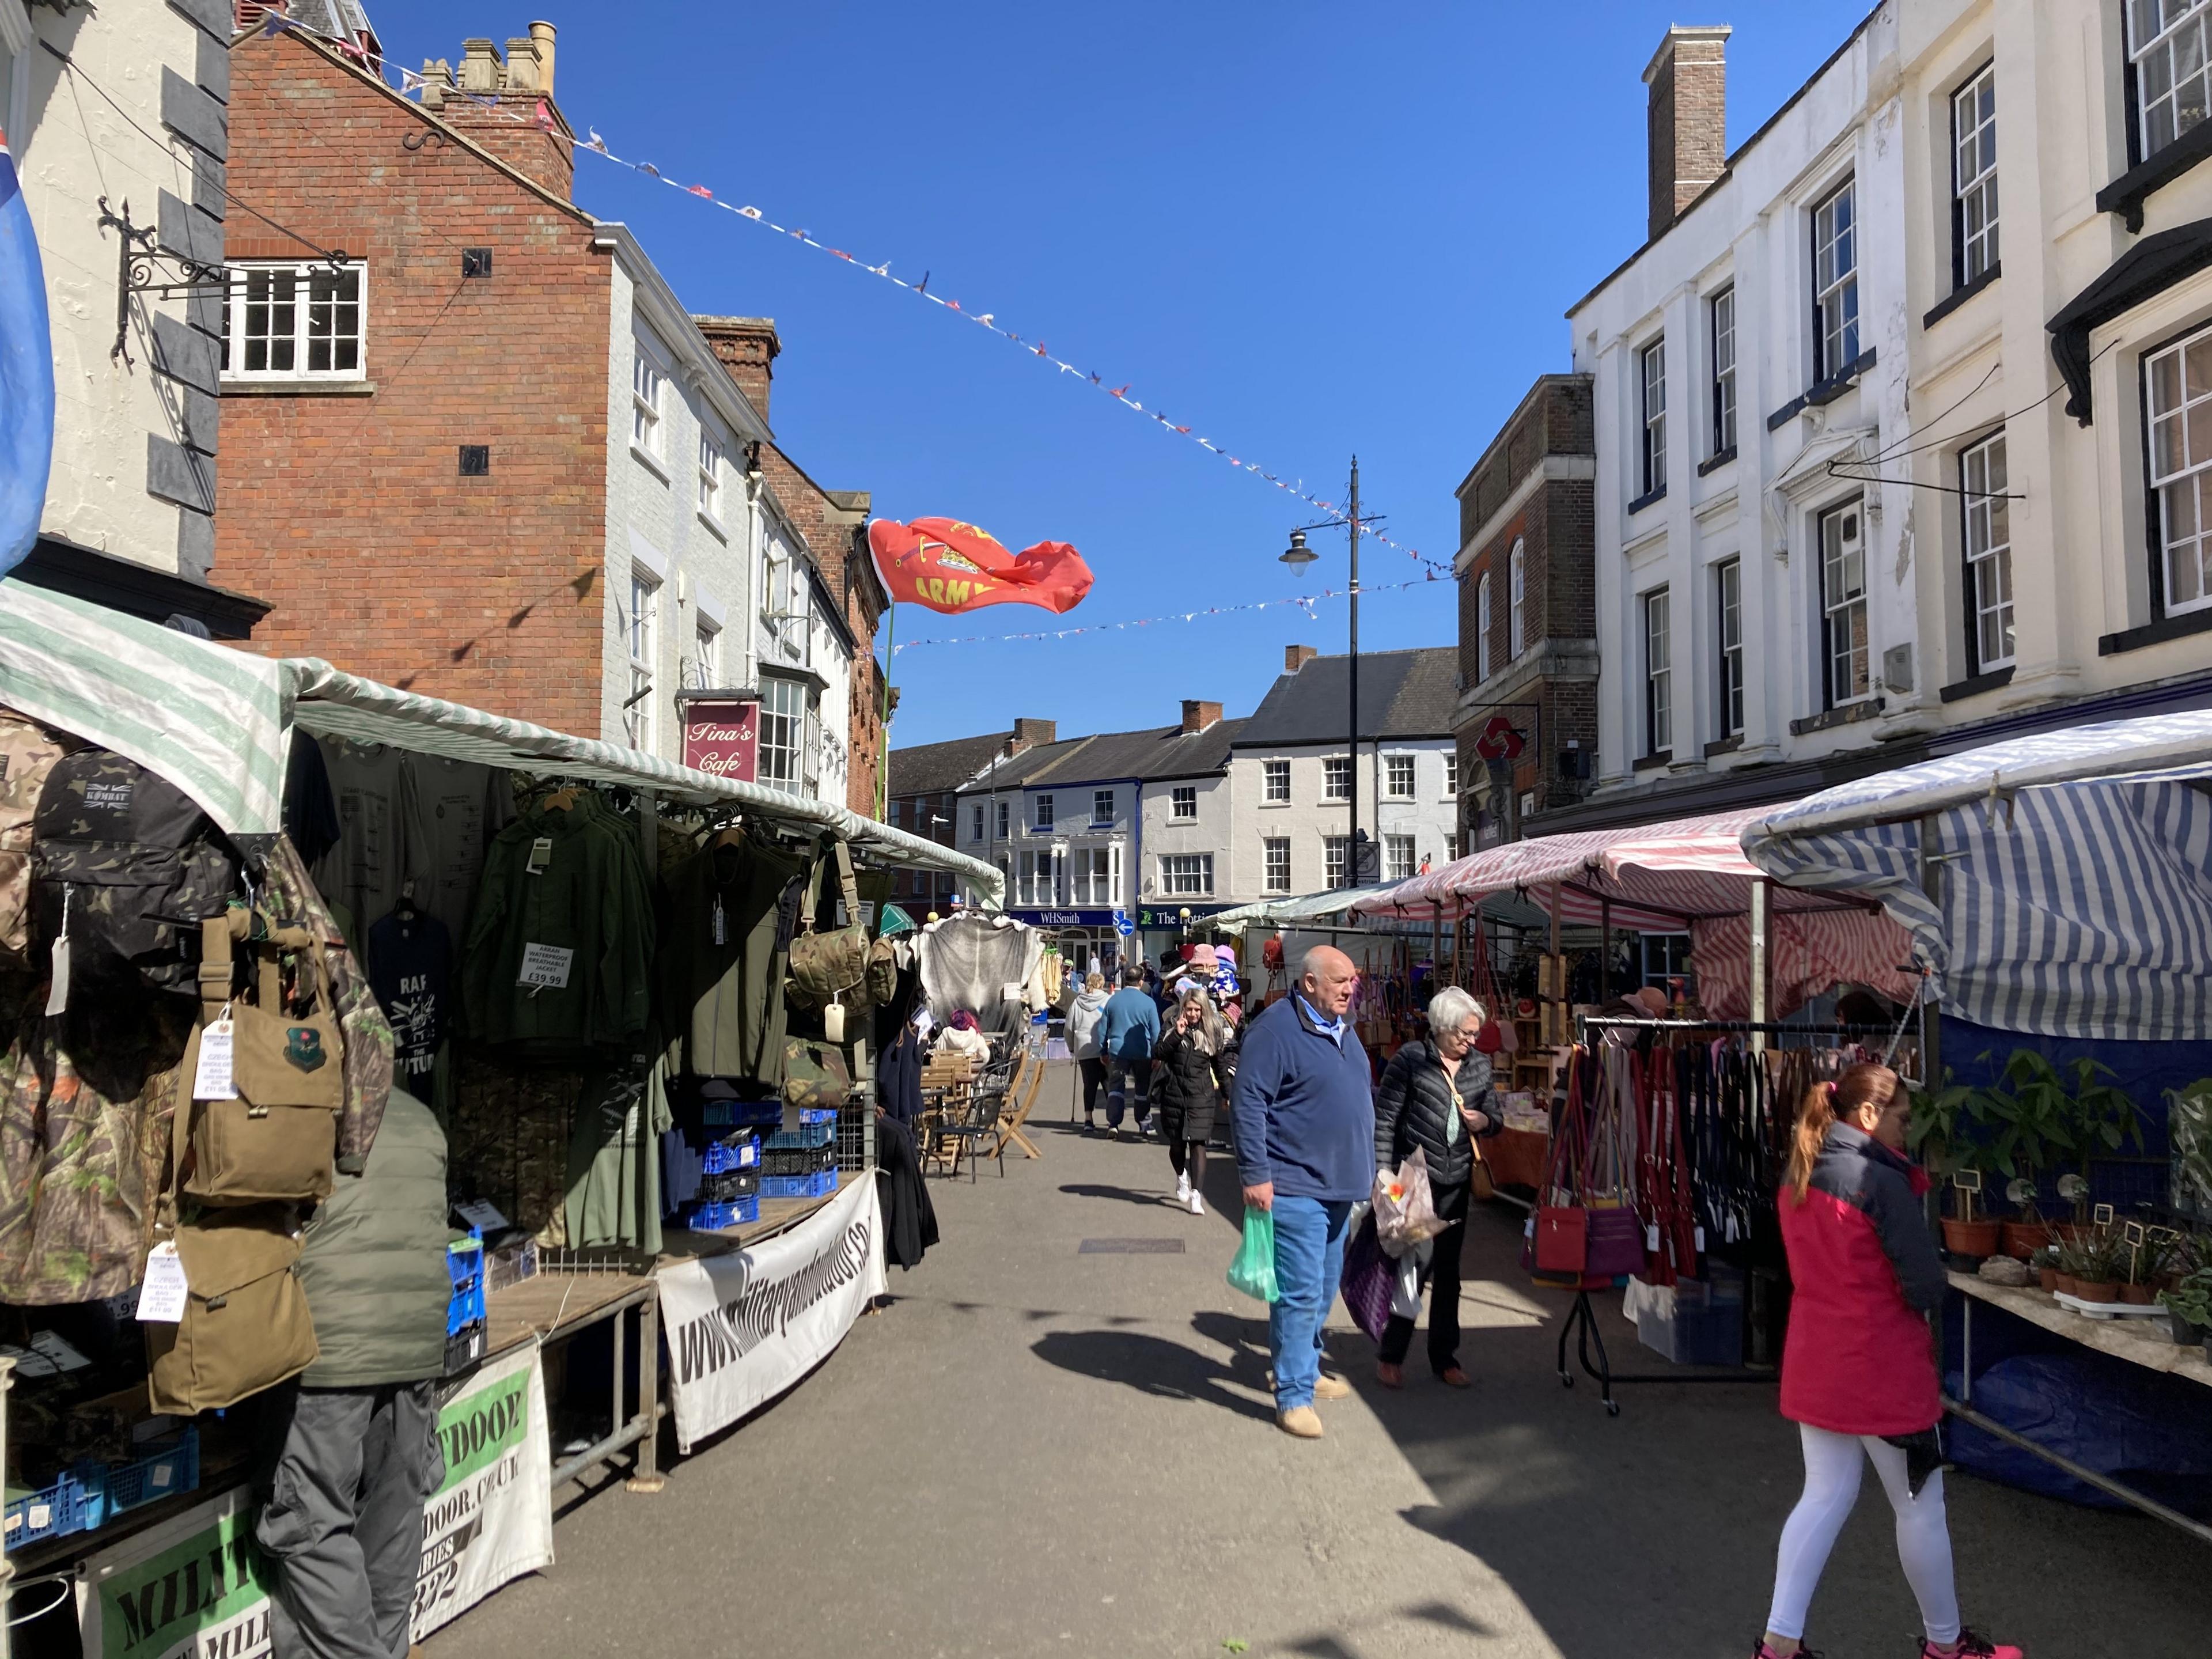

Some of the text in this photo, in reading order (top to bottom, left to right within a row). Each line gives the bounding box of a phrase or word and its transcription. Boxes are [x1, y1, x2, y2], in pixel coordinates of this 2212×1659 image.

[916, 577, 996, 605] ARMY
[688, 722, 754, 741] Tina's
[699, 752, 742, 777] Cafe
[86, 790, 128, 801] KOMBAT
[1041, 912, 1080, 924] WHSmith
[1157, 911, 1176, 924] The
[529, 951, 568, 961] WATERPROOF
[539, 946, 560, 954] ARRAN
[528, 957, 565, 967] BREATHABLE
[535, 965, 558, 973] JACKET
[528, 972, 562, 985] £39.99
